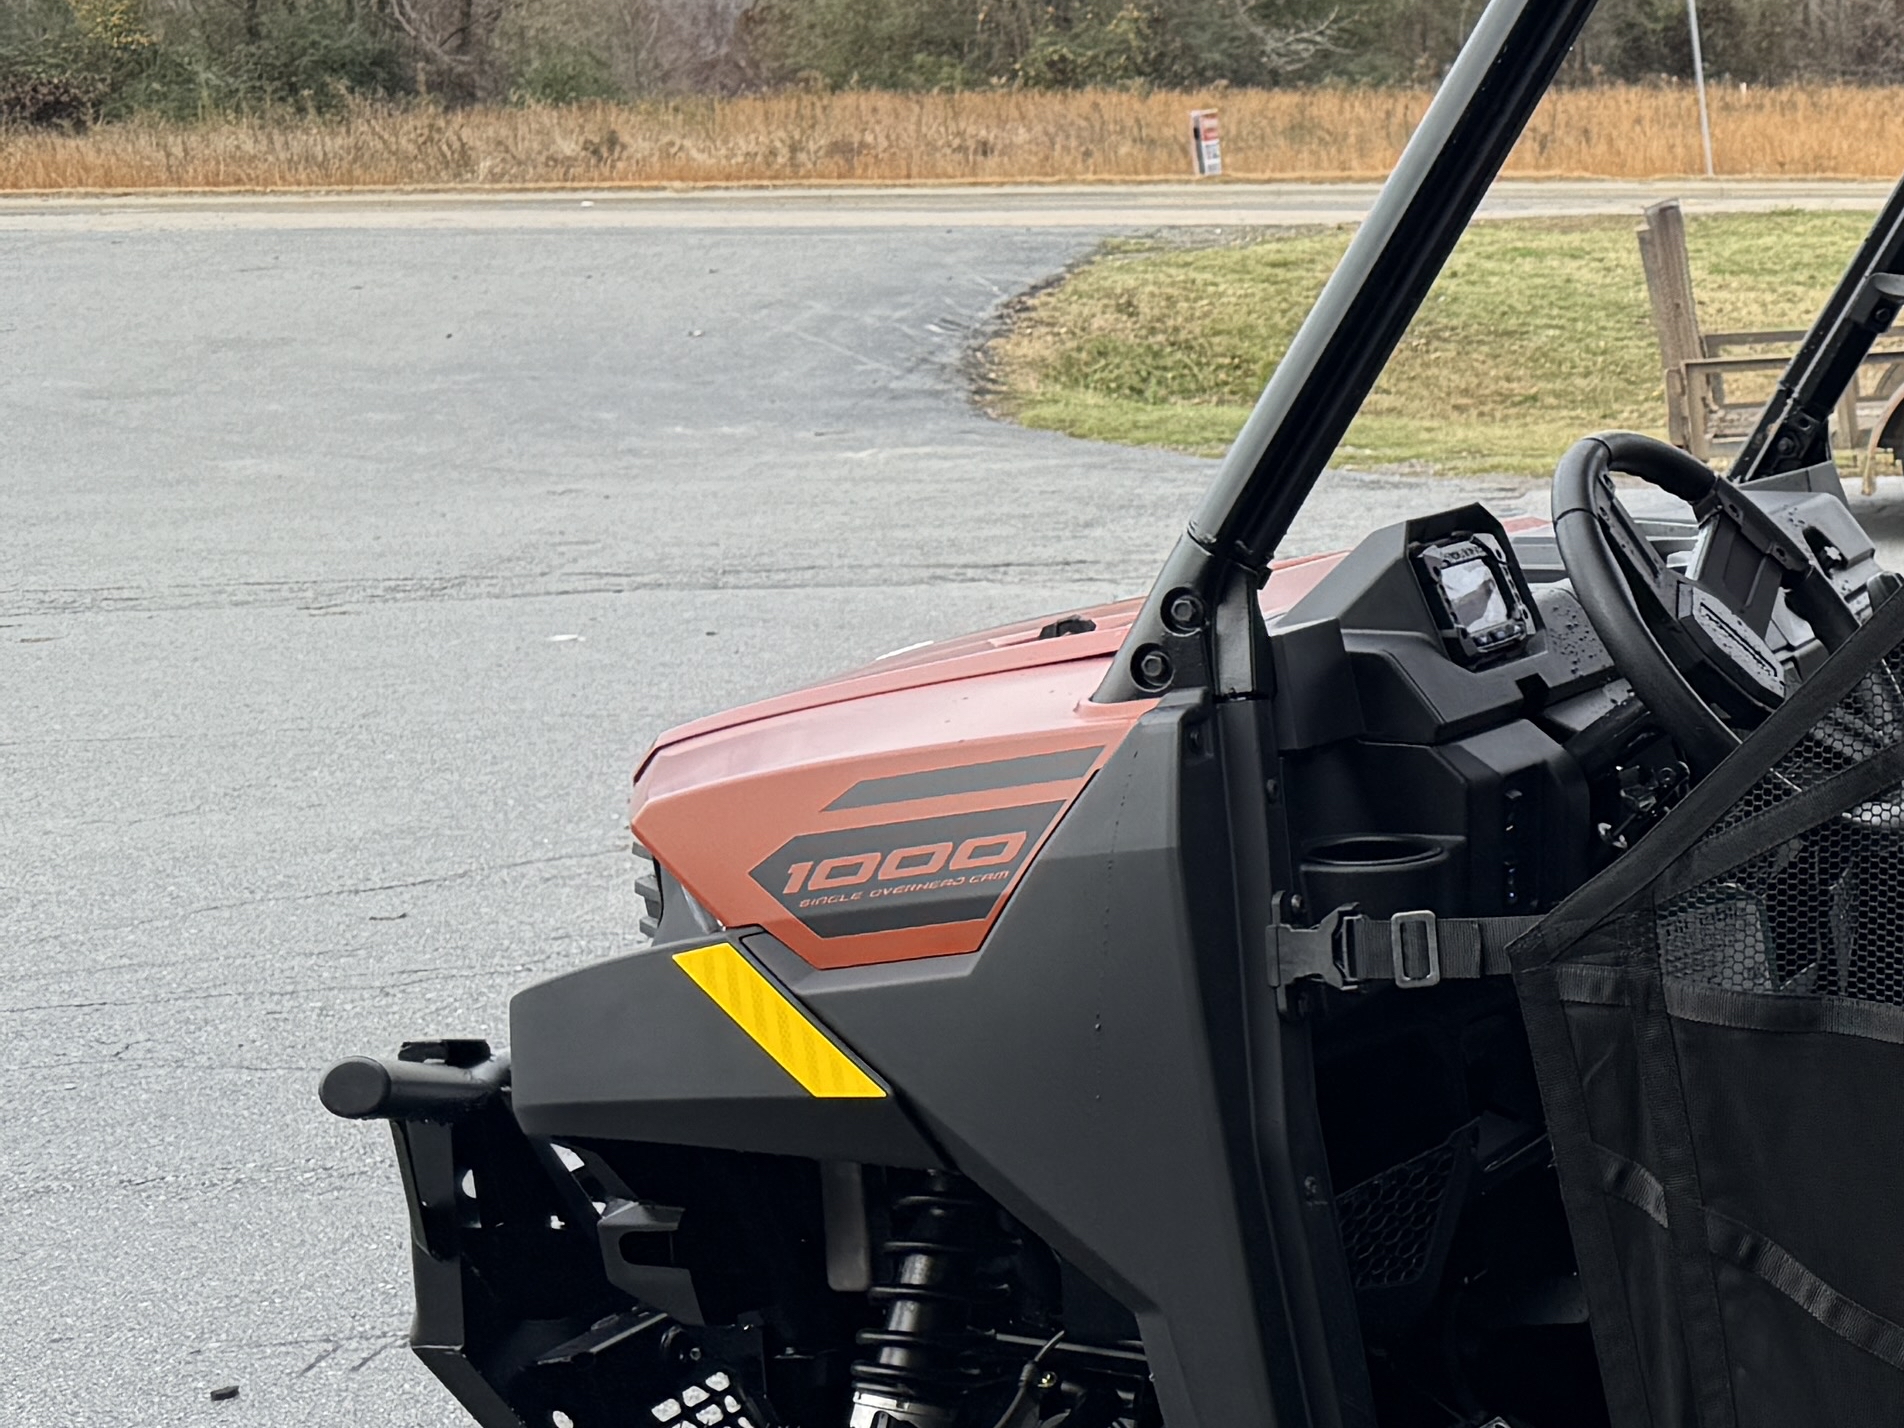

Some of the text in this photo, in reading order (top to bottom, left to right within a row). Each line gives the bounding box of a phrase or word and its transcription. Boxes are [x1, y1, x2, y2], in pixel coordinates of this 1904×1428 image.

[783, 831, 1027, 894] 1000
[799, 870, 1009, 908] SINGLE OVERHEAD CAM
